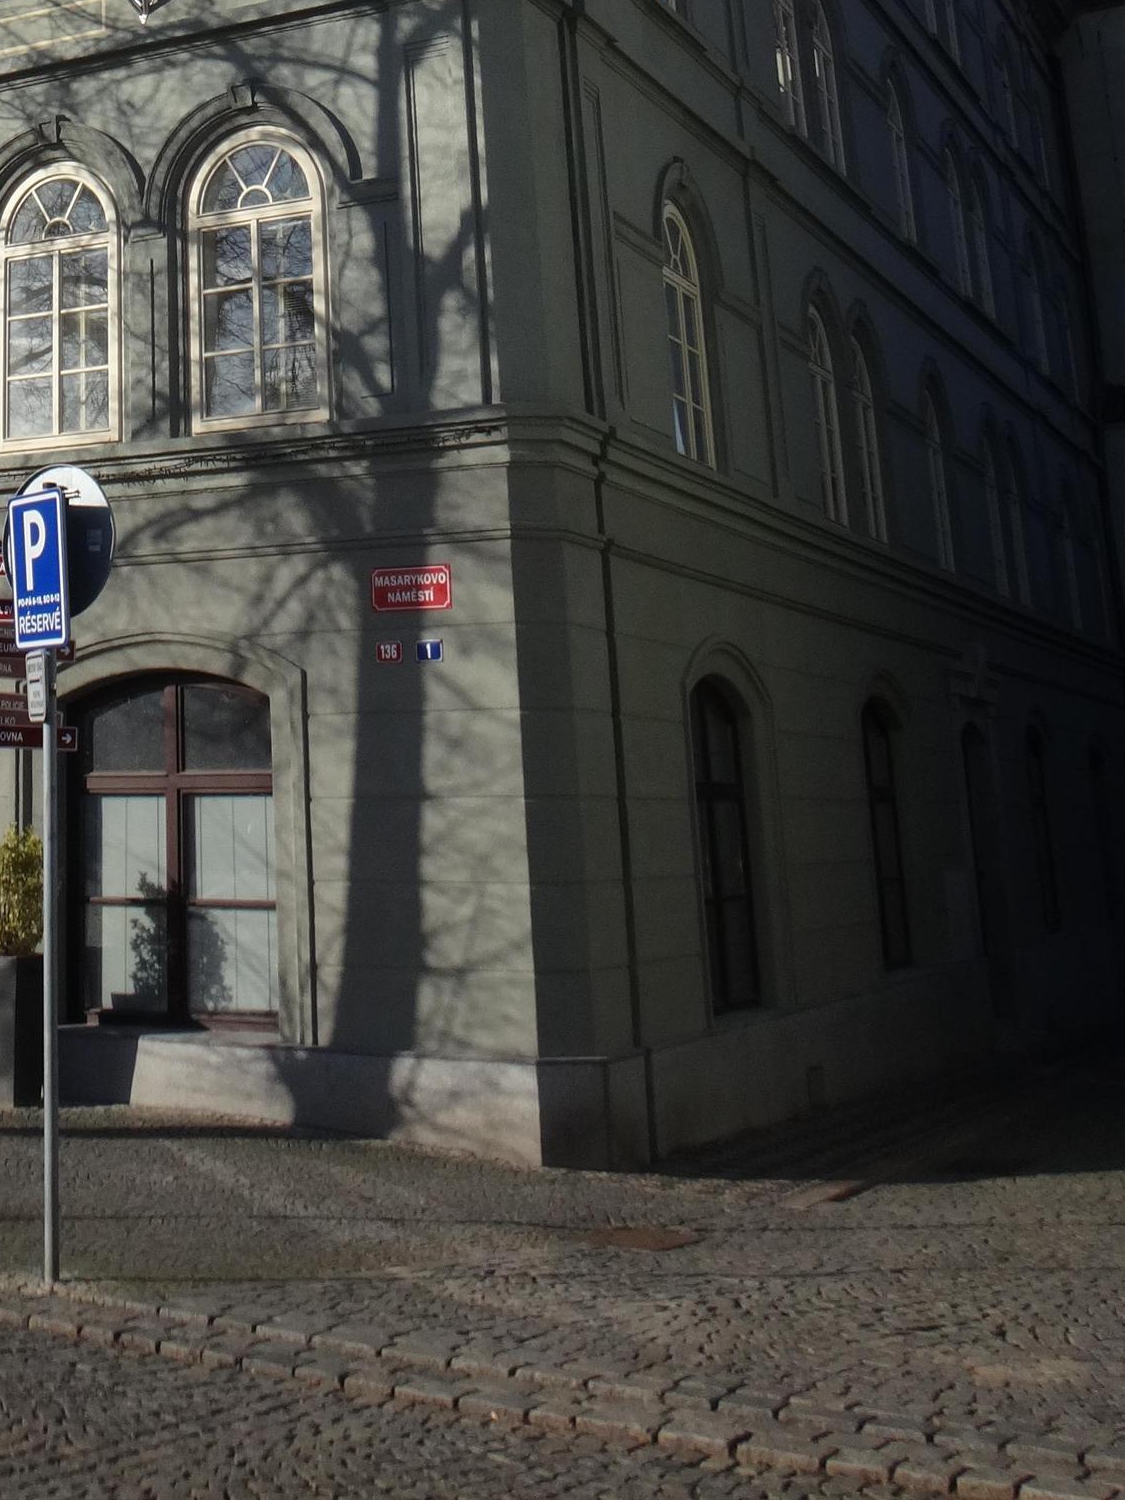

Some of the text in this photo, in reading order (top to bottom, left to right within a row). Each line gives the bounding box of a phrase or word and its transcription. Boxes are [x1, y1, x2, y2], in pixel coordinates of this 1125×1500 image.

[23, 509, 46, 591] P
[375, 572, 446, 588] MASARYKOVO
[387, 587, 434, 603] NÁMĚSTÍ
[19, 606, 61, 634] RÉSERVÉ
[380, 643, 398, 660] 136
[426, 642, 432, 659] 1
